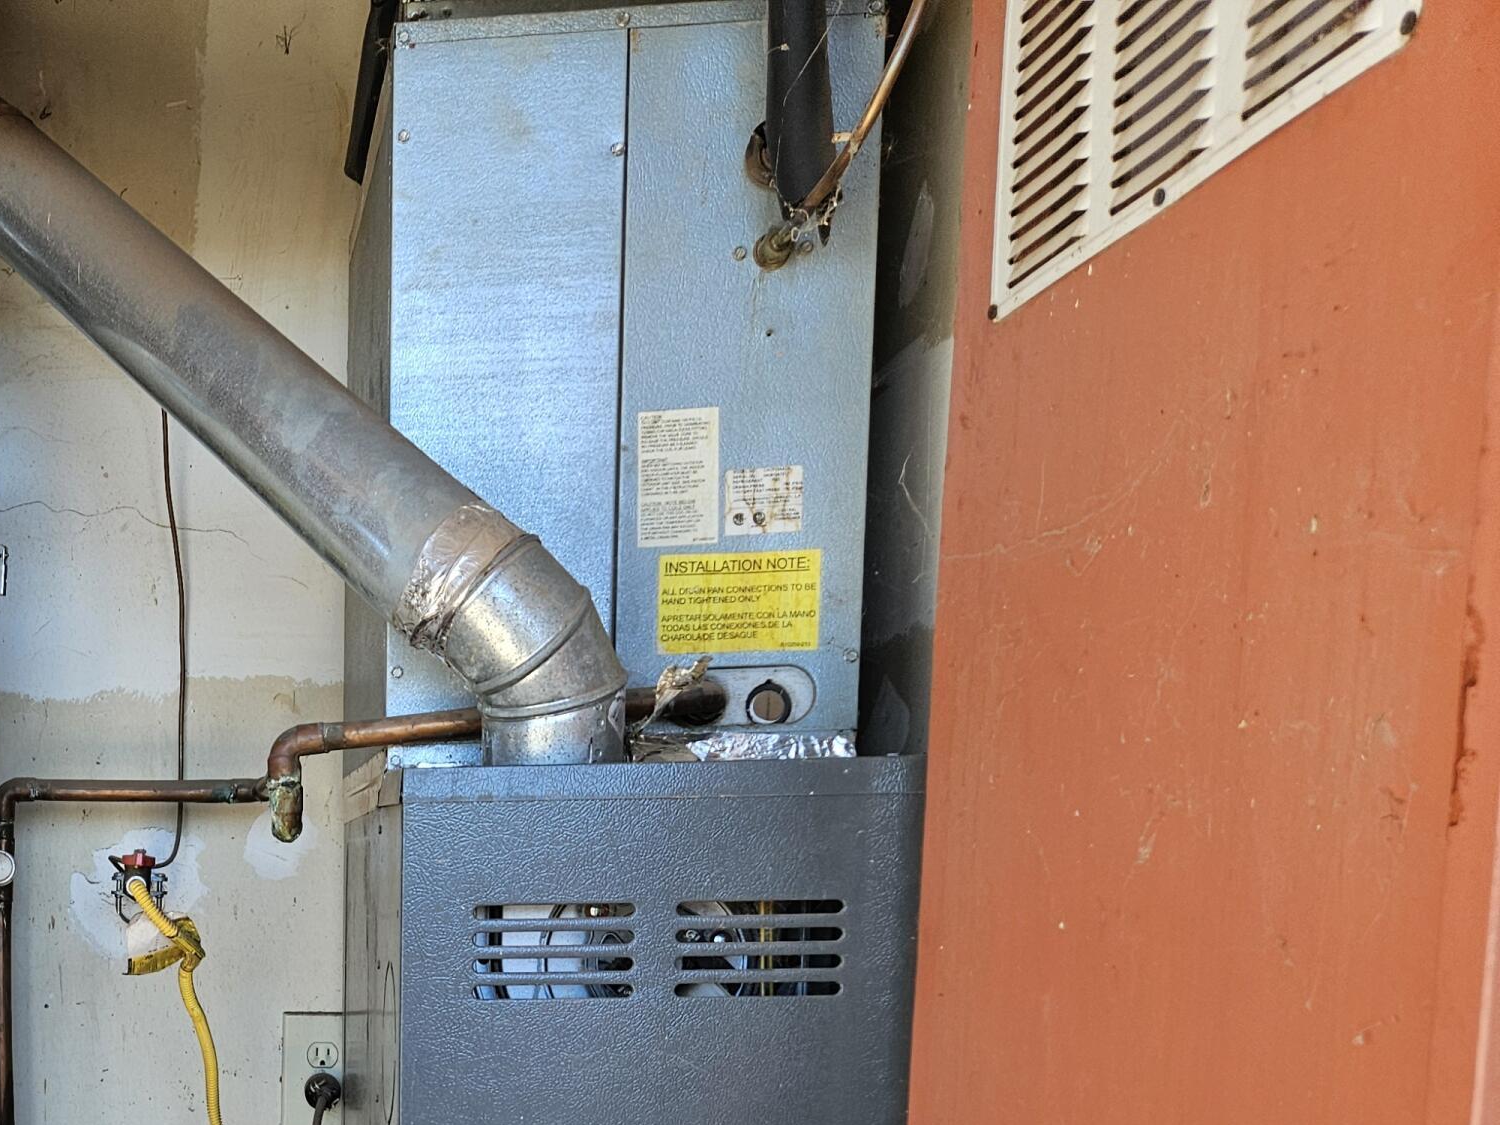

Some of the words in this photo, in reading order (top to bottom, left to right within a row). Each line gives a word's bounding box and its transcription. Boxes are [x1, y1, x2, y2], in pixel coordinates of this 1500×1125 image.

[665, 559, 762, 574] INSTALLATION
[766, 556, 810, 570] NOTE:
[662, 588, 676, 596] ALL
[707, 586, 724, 594] PAN
[726, 584, 788, 594] CONNECTIONS
[791, 583, 802, 591] TO
[805, 582, 817, 591] BE
[661, 597, 686, 605] HAND
[688, 596, 736, 604] TIGHTENED
[738, 594, 761, 602] ONLY
[661, 614, 701, 622] APRETAR
[703, 612, 754, 622] SOLAMENTE
[756, 611, 775, 619] CON
[777, 610, 788, 618] LA
[789, 609, 816, 618] MANO
[662, 624, 690, 632] TODAS
[693, 623, 709, 631] LAS
[710, 621, 766, 630] CONEXIONES
[768, 620, 780, 628] DE
[782, 620, 793, 628] LA
